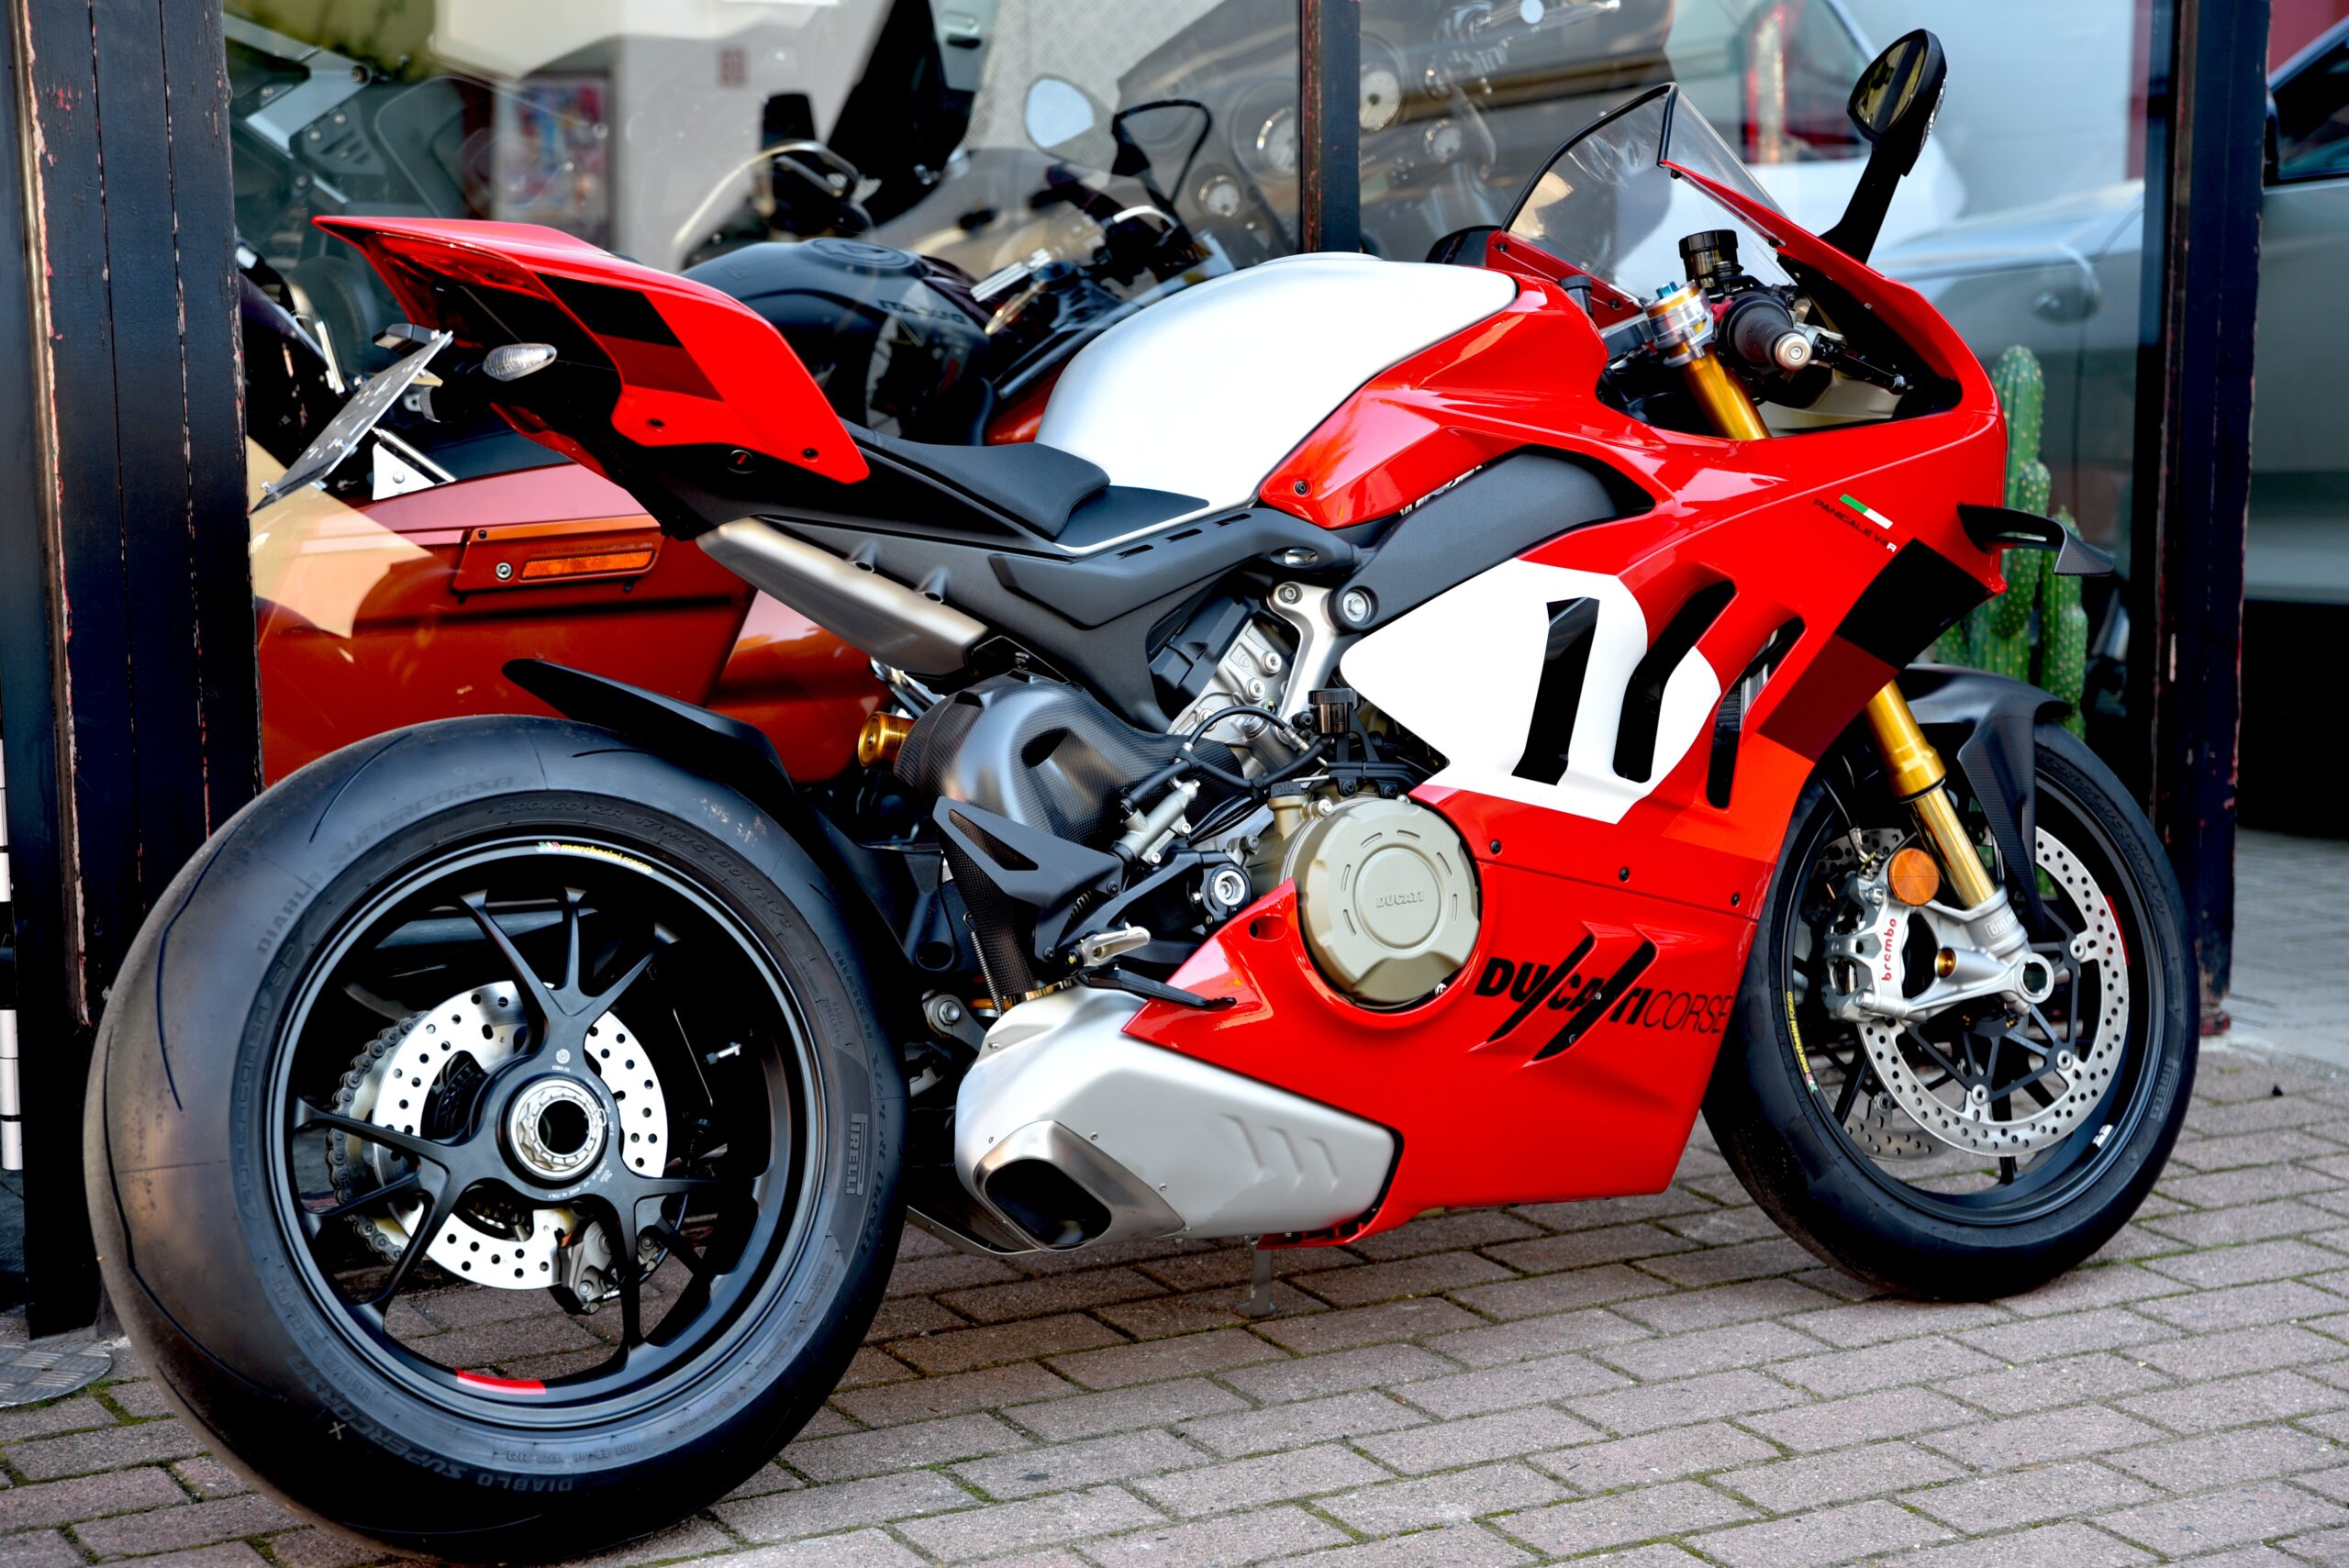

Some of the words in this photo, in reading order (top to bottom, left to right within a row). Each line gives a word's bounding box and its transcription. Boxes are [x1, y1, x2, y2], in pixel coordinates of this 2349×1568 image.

[1813, 498, 1873, 538] PANIGALE
[327, 775, 514, 866] SUPERCORSA
[1276, 783, 1295, 794] OIL
[1375, 888, 1425, 908] DUCATI
[1881, 917, 1898, 982] brembo
[1474, 956, 1653, 1026] DUCATI
[1642, 990, 1733, 1034] CORSE
[1788, 1019, 1810, 1073] marchesini
[2149, 1058, 2179, 1125] PIRELLI
[843, 1112, 868, 1196] PIRELLI
[285, 1355, 468, 1483] SUPERCORSA
[476, 1472, 574, 1493] DIABLO
